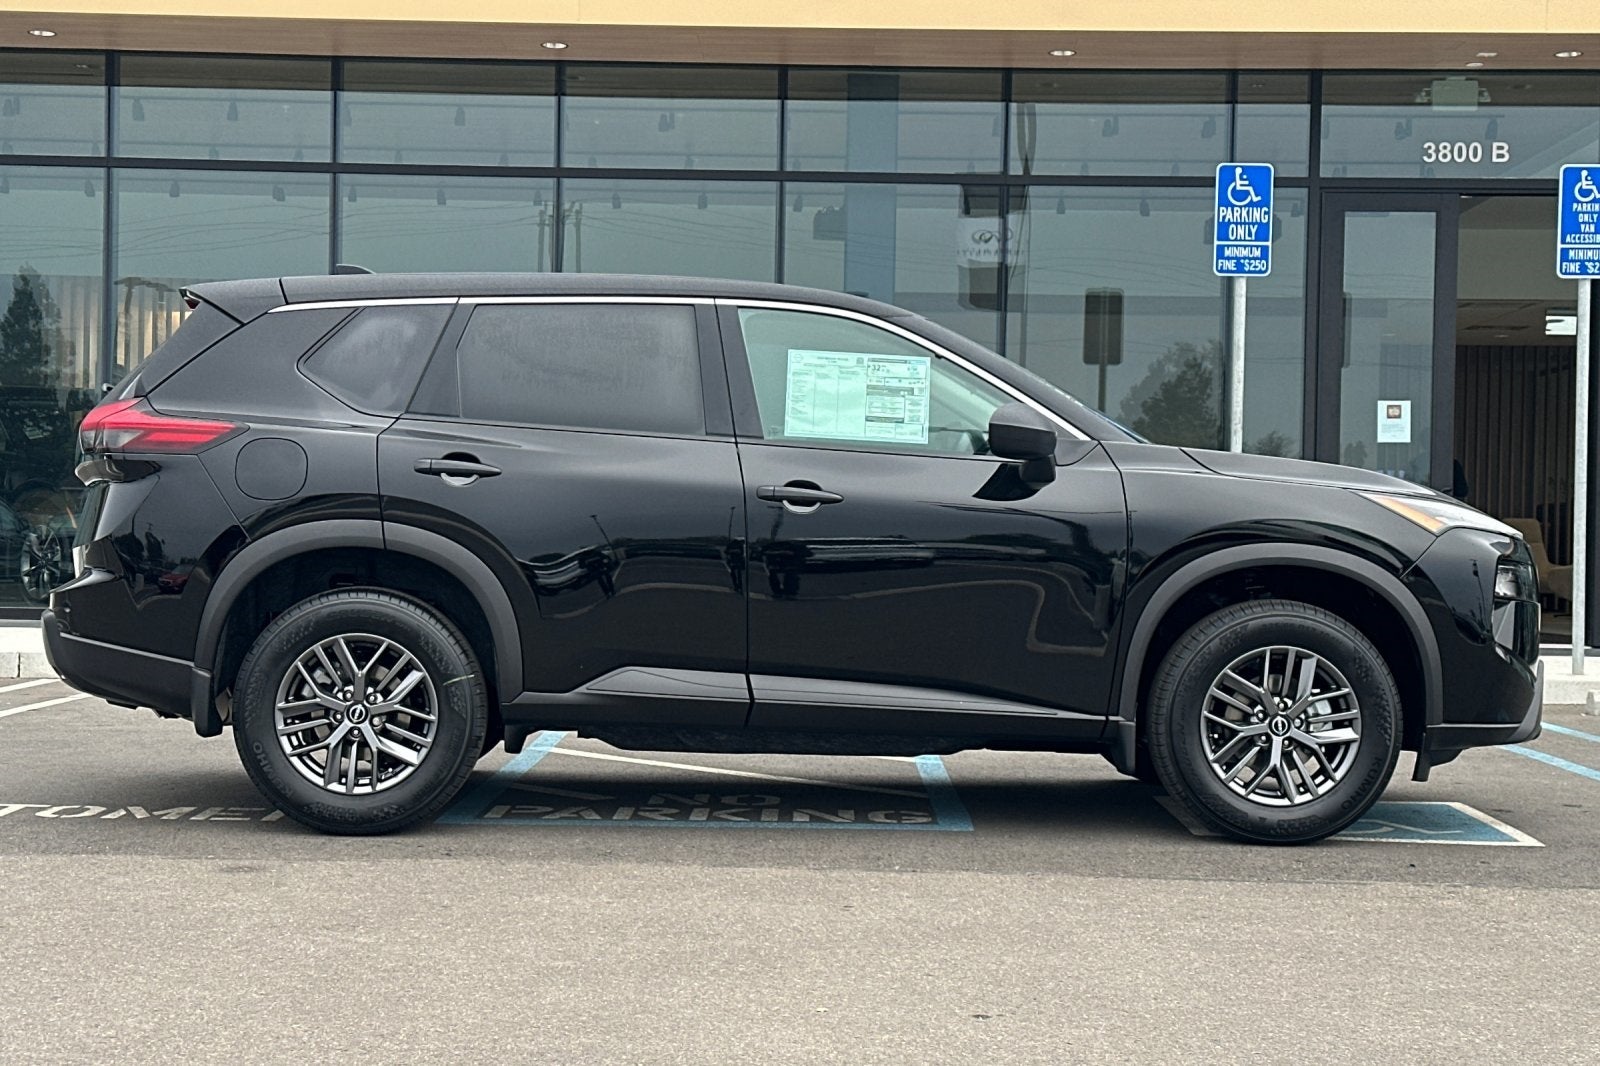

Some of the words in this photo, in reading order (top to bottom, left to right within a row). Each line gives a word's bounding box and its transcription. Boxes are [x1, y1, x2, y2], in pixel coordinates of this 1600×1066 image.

[1422, 141, 1483, 163] 3800
[1491, 141, 1510, 163] B
[1572, 203, 1600, 212] PARKIN
[1219, 206, 1269, 223] PARKING
[1578, 213, 1599, 223] ONLY
[1228, 223, 1258, 241] ONLY
[1580, 223, 1596, 233] VAN
[1565, 234, 1600, 243] ACCESSIB
[1224, 246, 1261, 258] MINIMUM
[1568, 249, 1600, 260] MINIMU
[1217, 259, 1237, 271] FINE
[1562, 262, 1581, 273] FINE
[1587, 262, 1600, 274] $2
[1340, 756, 1383, 810] KUMHO
[647, 793, 783, 807] NO
[482, 805, 933, 824] PARKING
